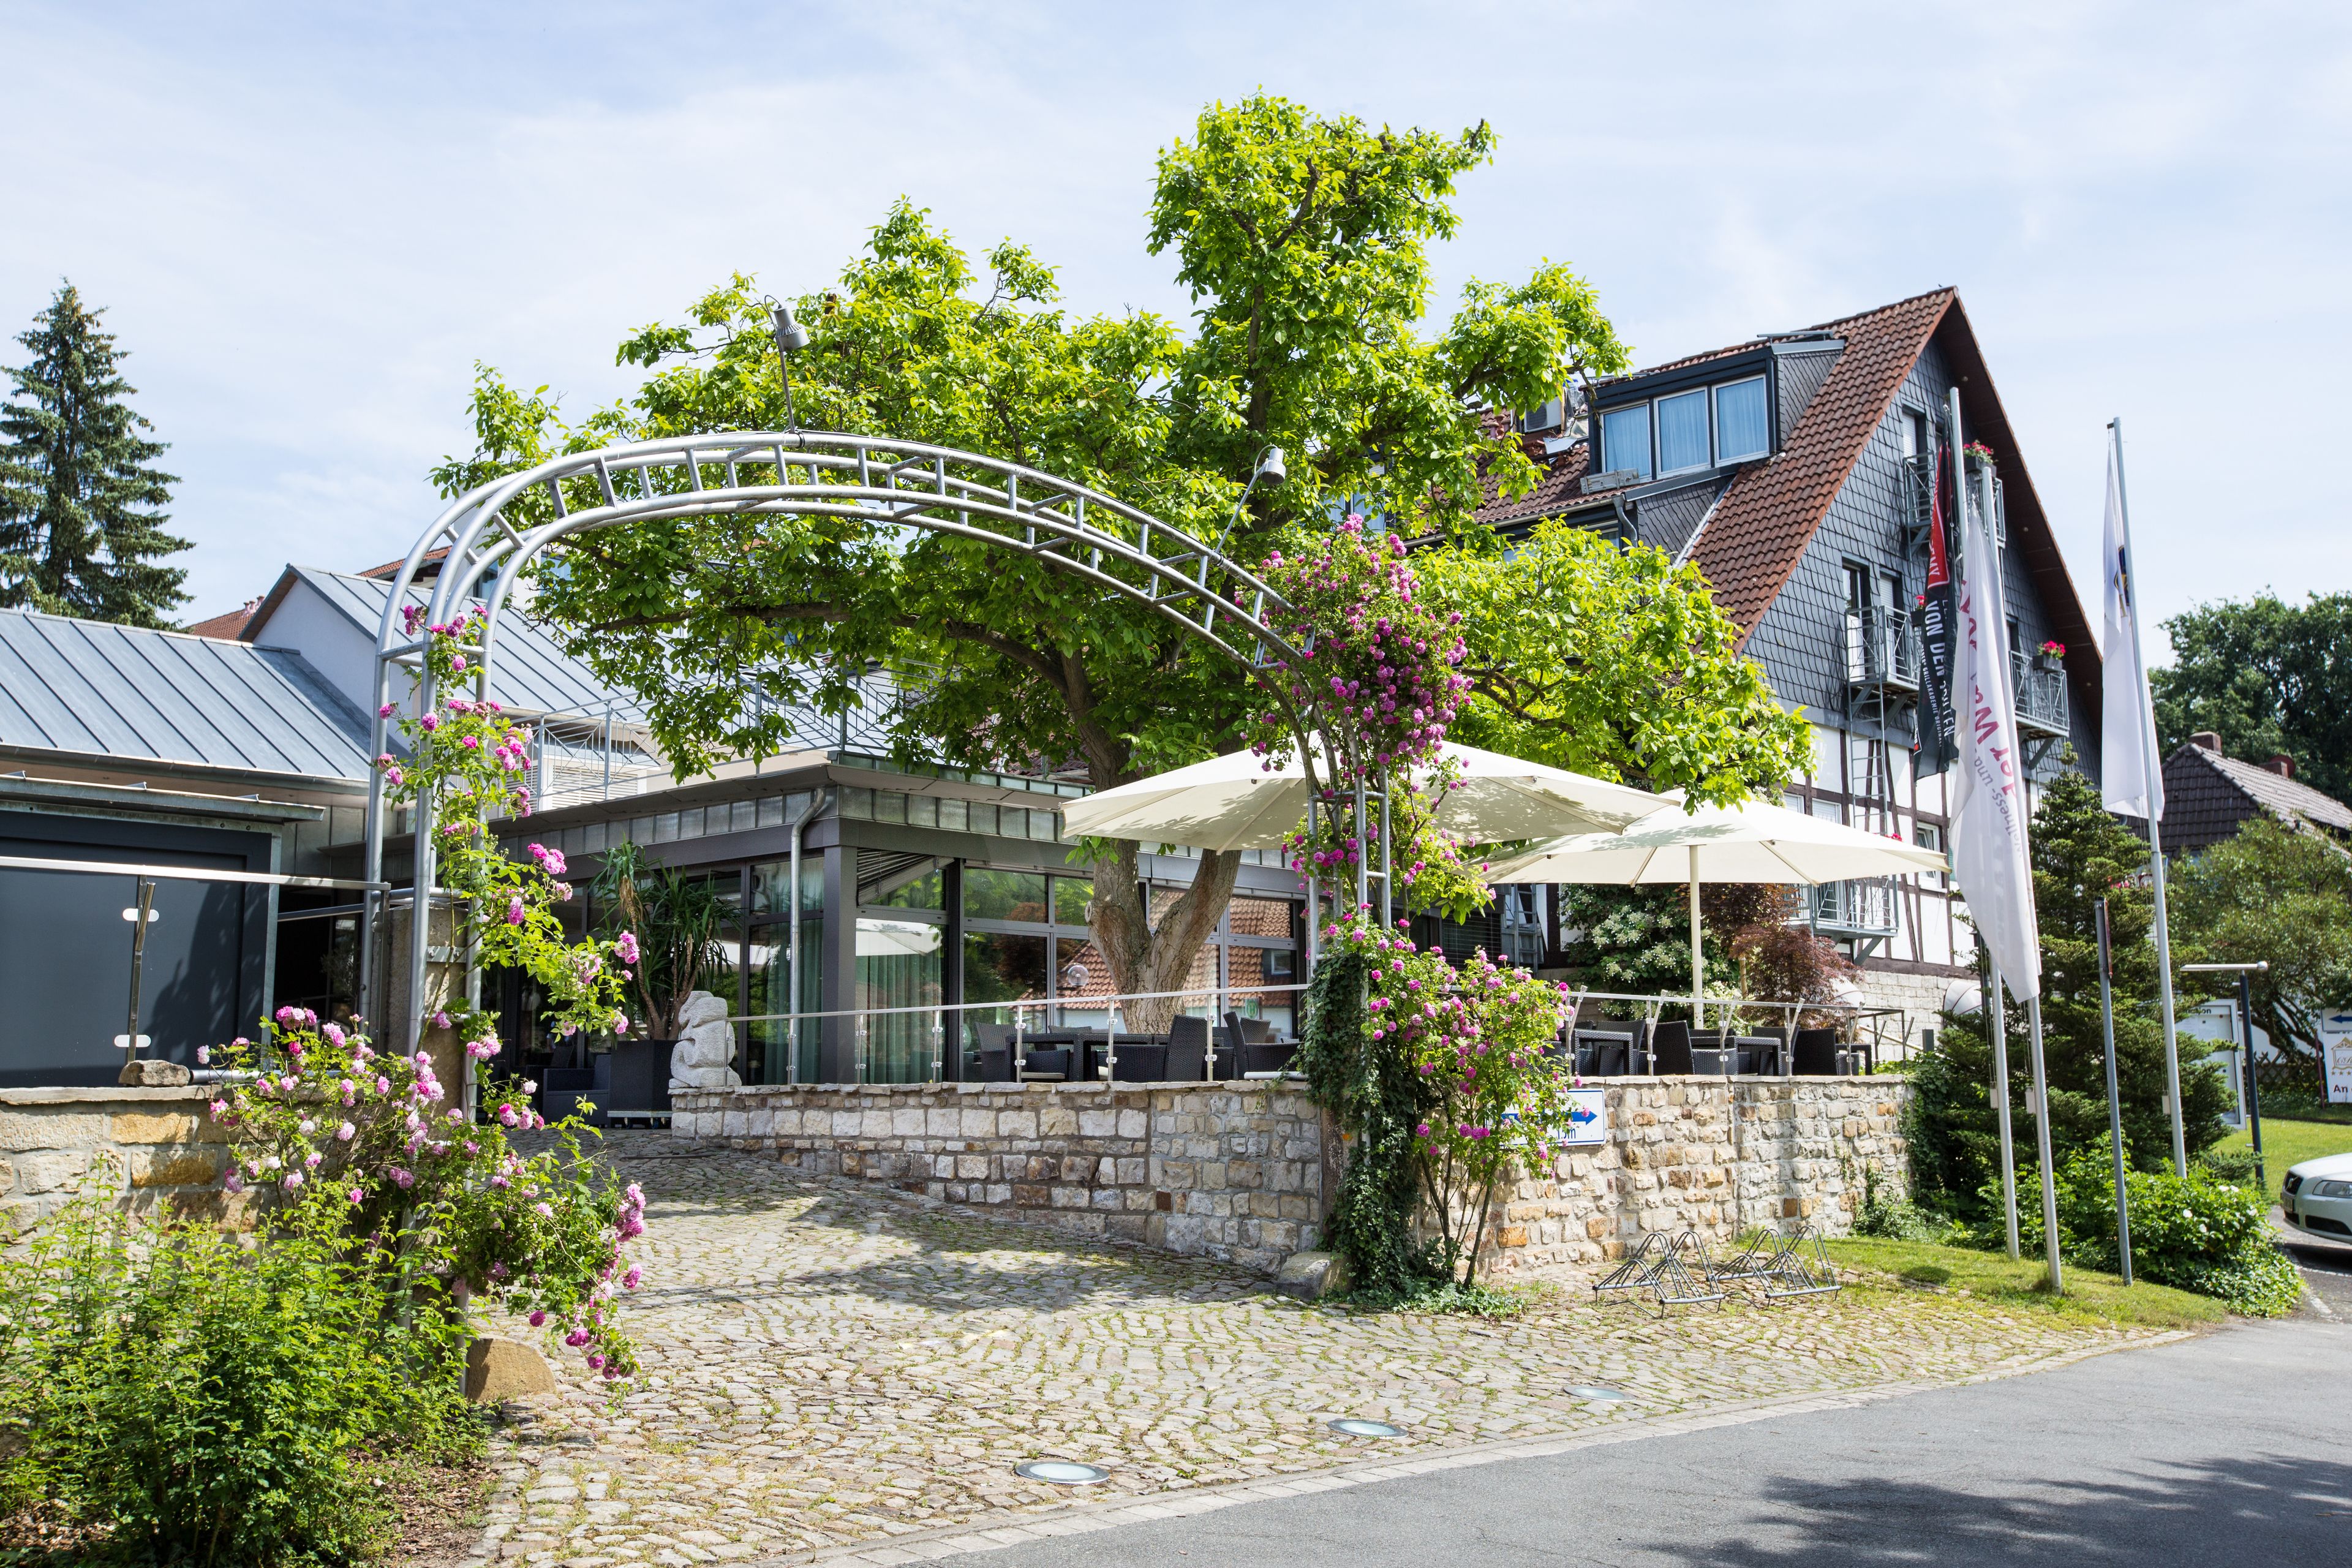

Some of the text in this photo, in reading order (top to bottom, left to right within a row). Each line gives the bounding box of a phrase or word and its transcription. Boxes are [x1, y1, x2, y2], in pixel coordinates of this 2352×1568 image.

[1925, 600, 1944, 636] VON
[1930, 643, 1945, 677] DEN
[1922, 667, 1939, 715] GRILLAKADEMIE
[2333, 1084, 2348, 1093] An
